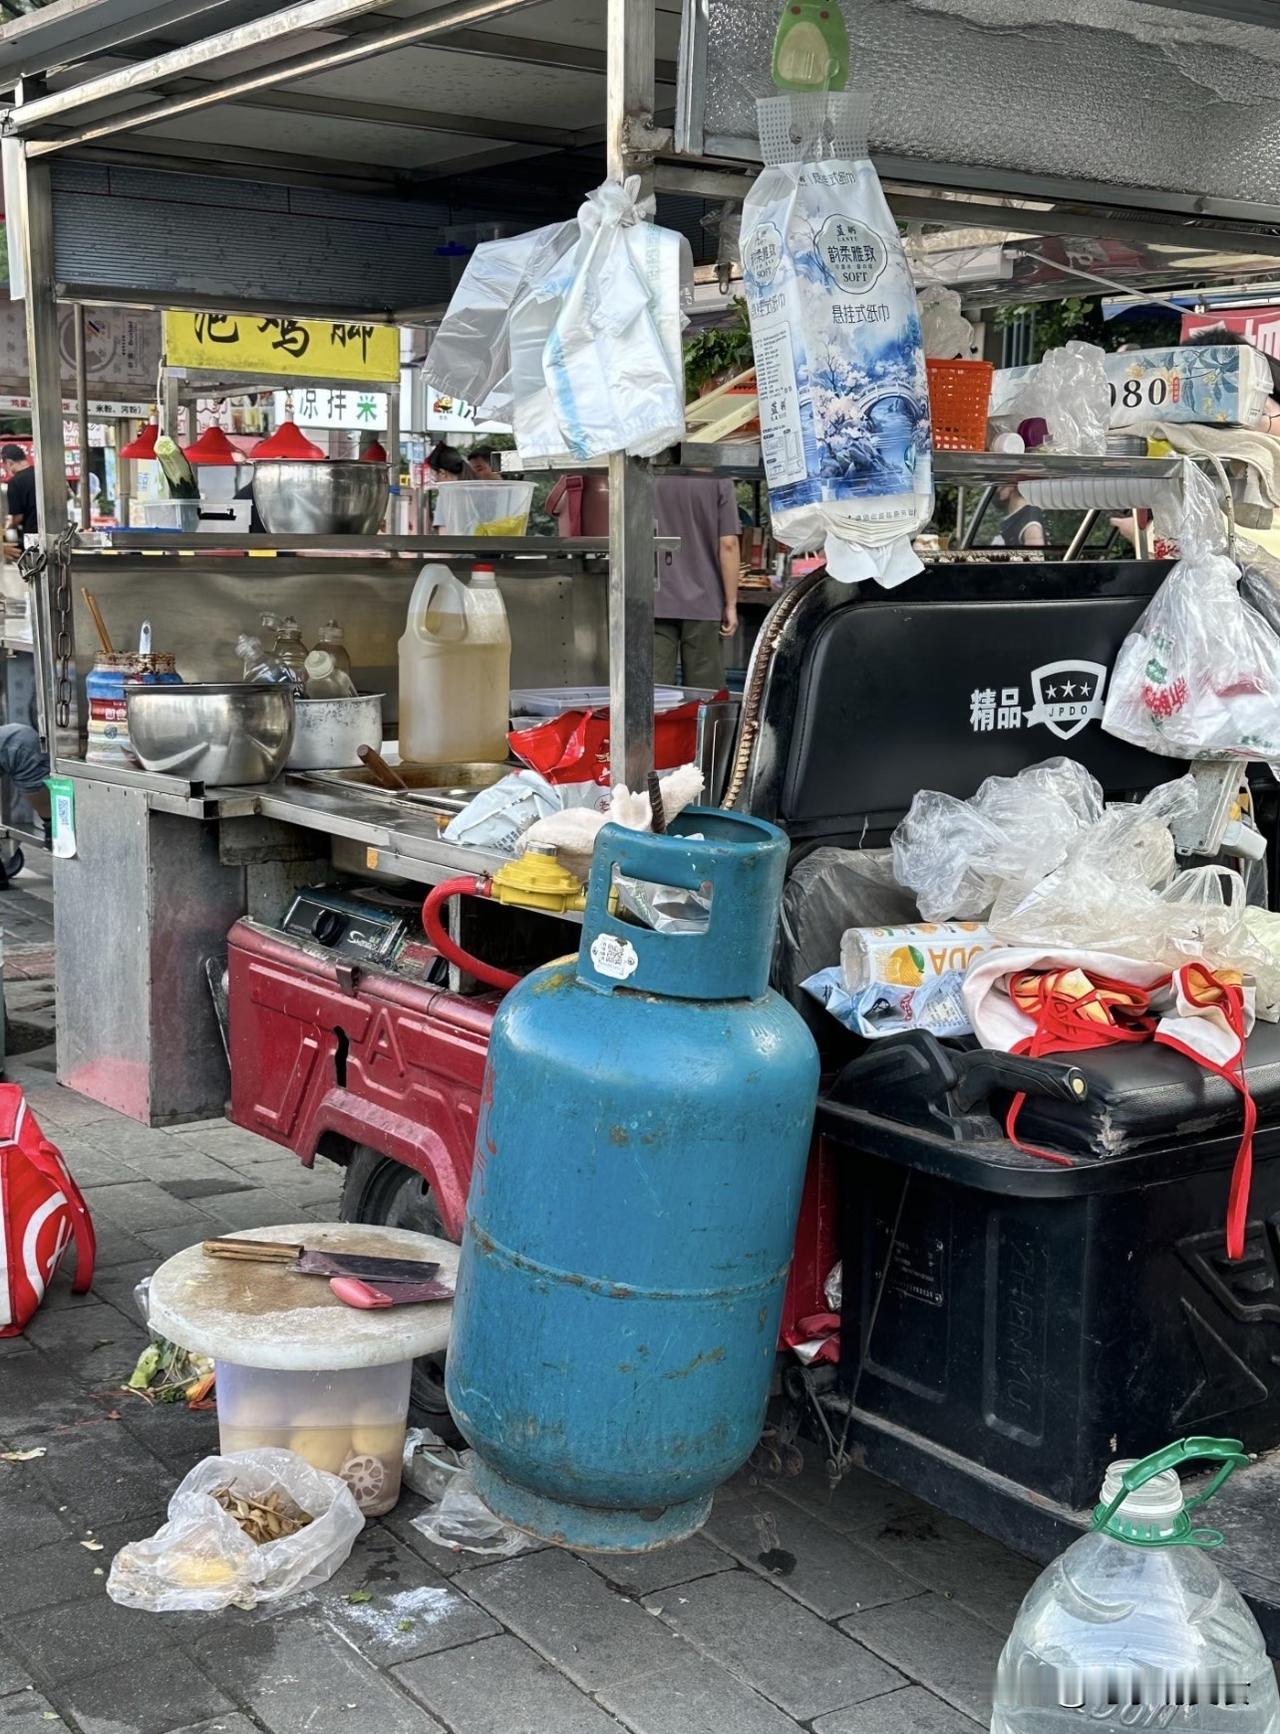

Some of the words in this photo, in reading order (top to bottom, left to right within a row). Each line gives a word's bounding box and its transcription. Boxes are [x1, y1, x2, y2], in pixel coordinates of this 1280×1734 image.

[827, 245, 876, 263] 韵柔雅致
[842, 272, 868, 282] SOFT
[832, 304, 890, 323] 悬挂式纸巾
[970, 687, 1021, 731] 精品
[1049, 705, 1087, 717] JPDO
